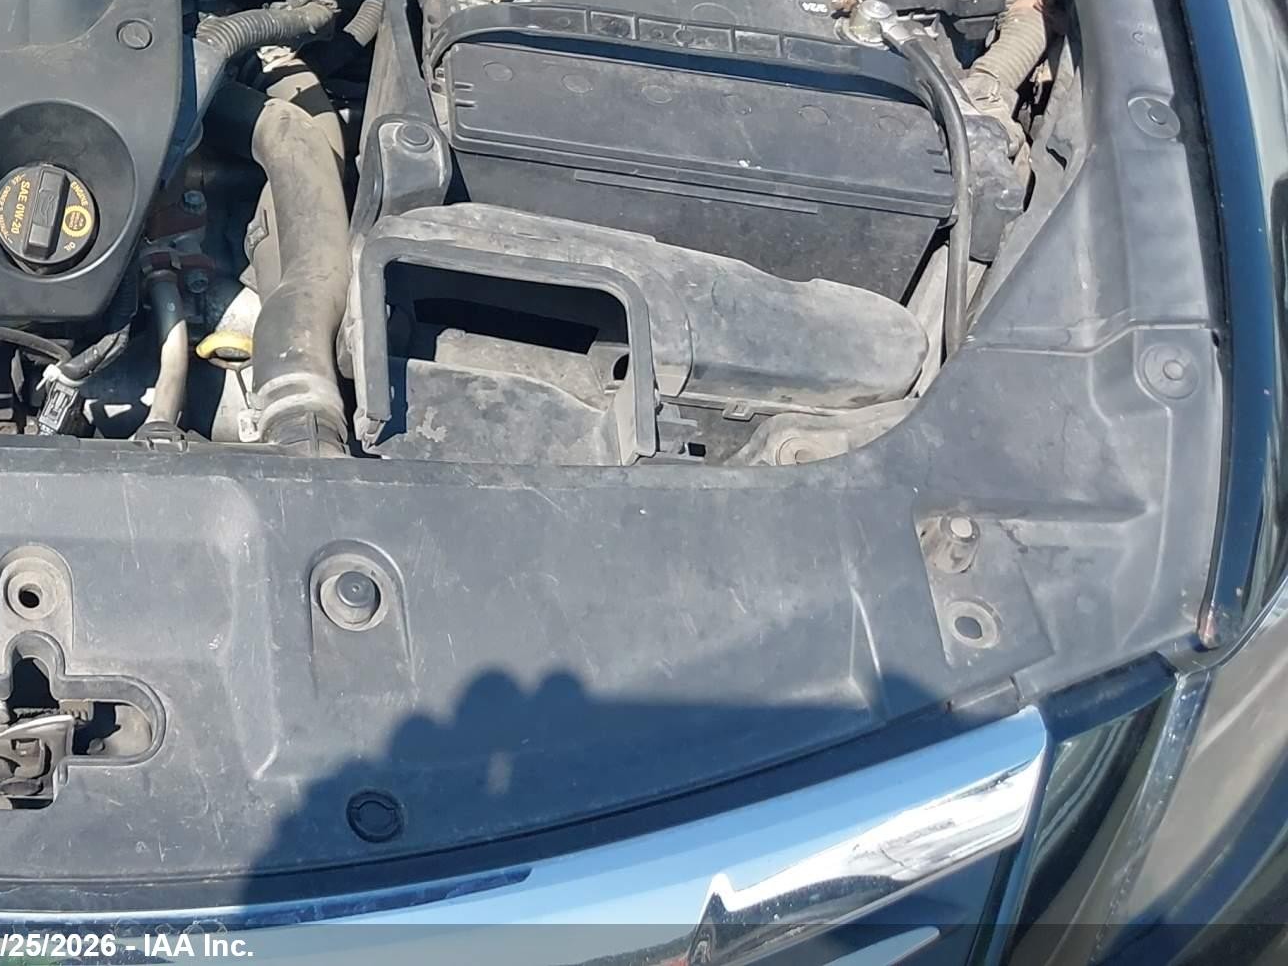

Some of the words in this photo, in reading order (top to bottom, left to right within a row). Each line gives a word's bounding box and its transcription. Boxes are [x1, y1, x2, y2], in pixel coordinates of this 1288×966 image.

[17, 180, 31, 203] SAE
[70, 181, 89, 207] ENGINE
[10, 203, 26, 235] 0W-20
[63, 241, 76, 252] OIL
